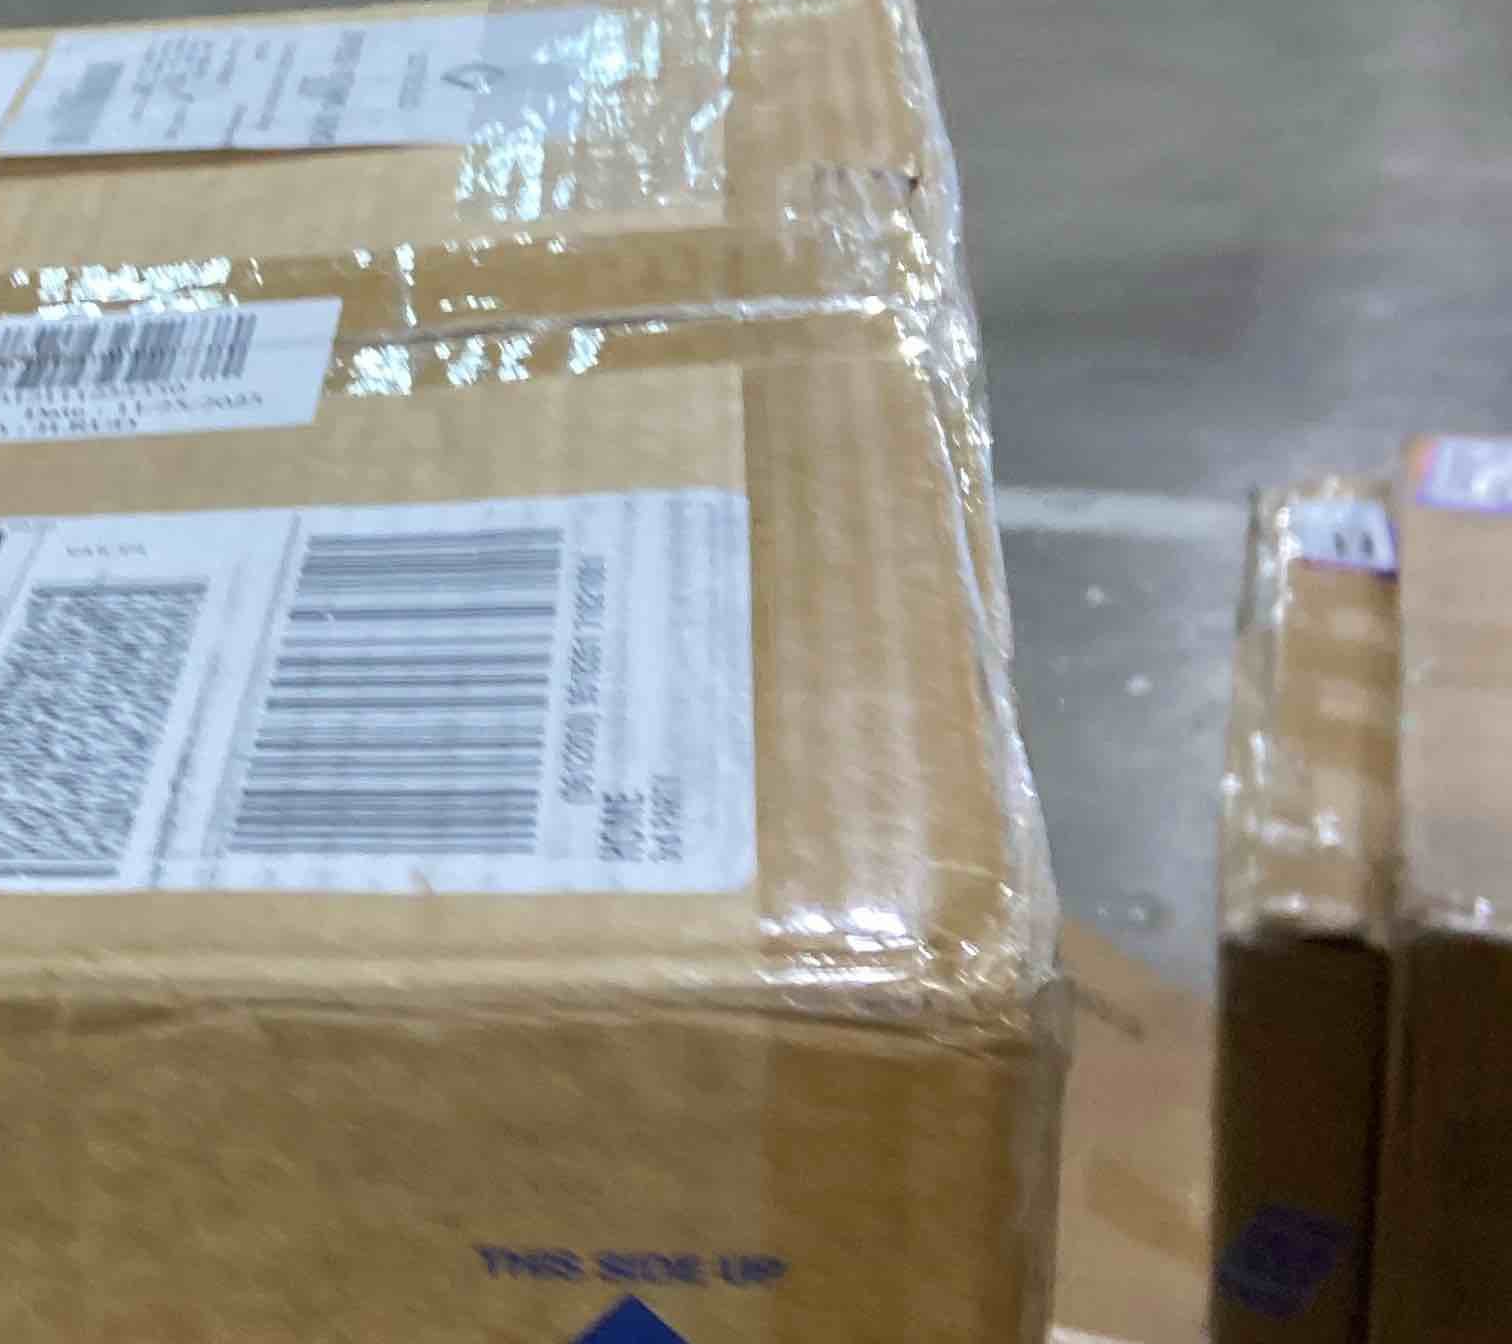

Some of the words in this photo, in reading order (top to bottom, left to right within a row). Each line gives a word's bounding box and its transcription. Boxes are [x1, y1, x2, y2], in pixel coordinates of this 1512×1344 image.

[474, 1245, 584, 1282] THIS
[595, 1249, 708, 1287] SIDE
[717, 1252, 788, 1288] UP
